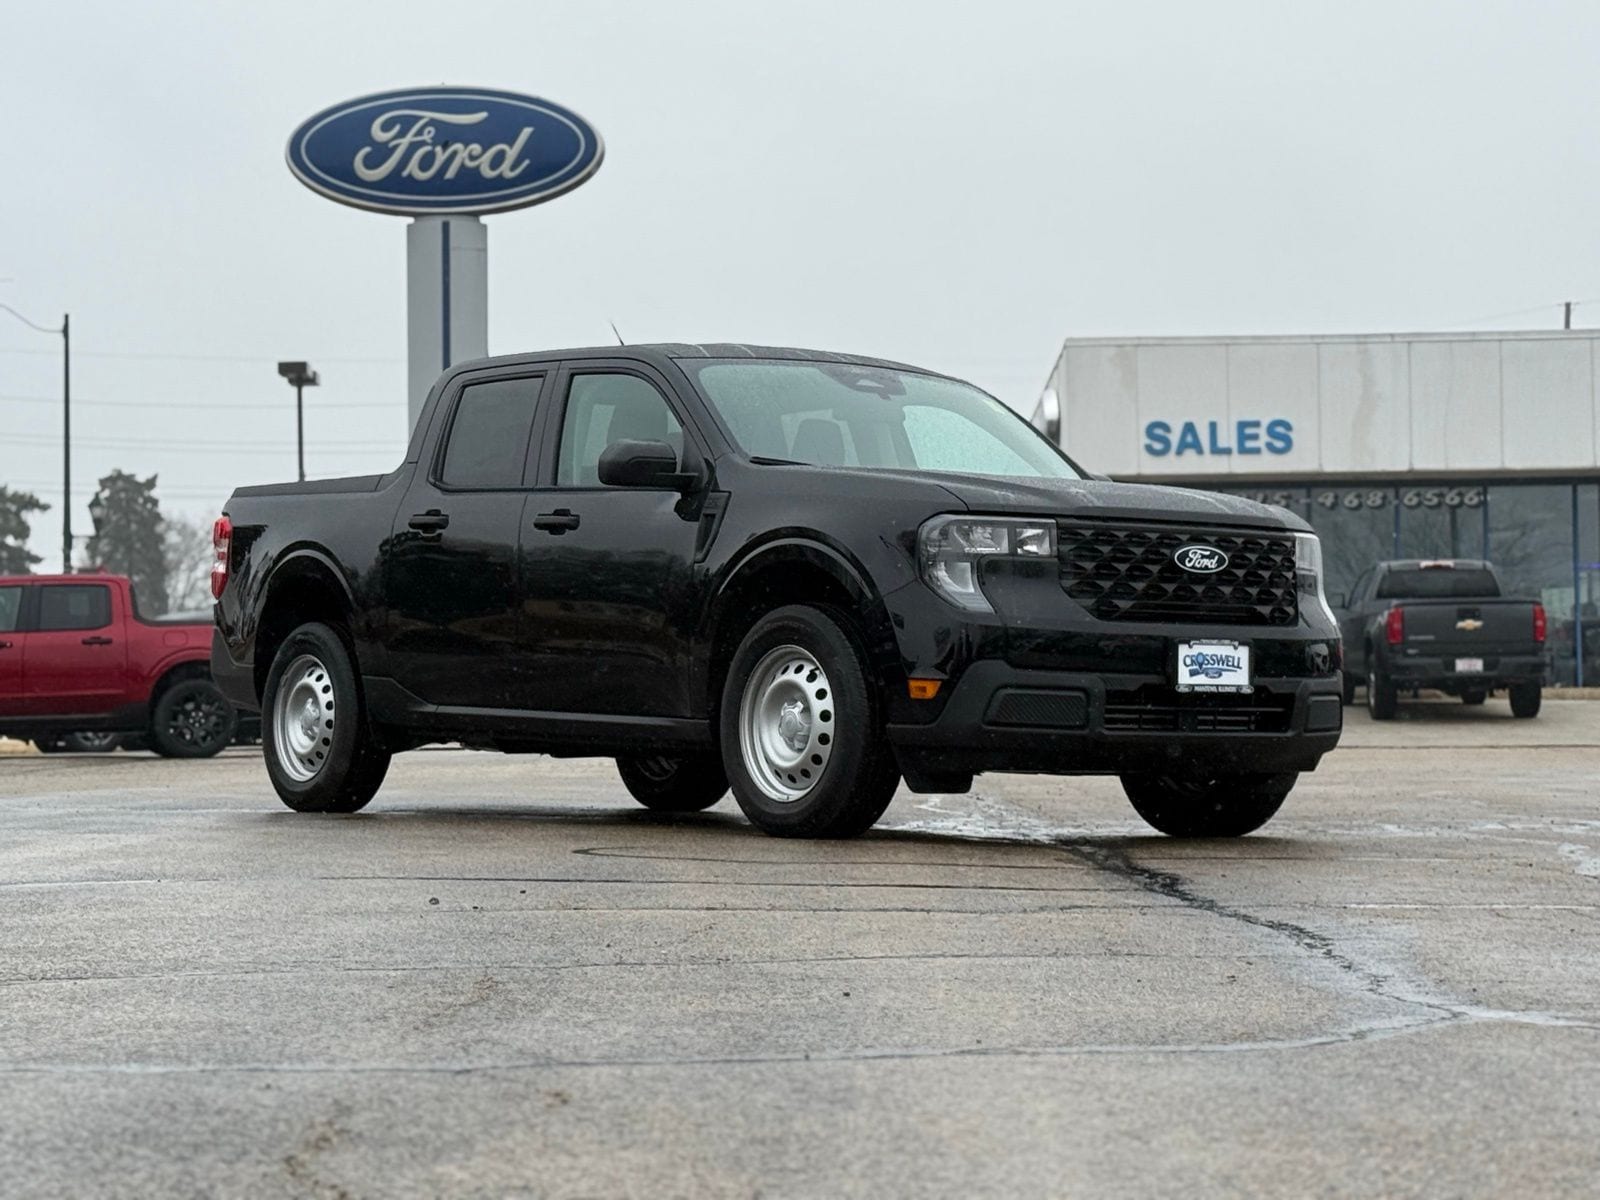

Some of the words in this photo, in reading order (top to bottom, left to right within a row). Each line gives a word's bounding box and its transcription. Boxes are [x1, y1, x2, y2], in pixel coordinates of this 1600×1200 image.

[354, 109, 535, 182] Ford
[1144, 419, 1293, 457] SALES
[1317, 491, 1385, 508] 468
[1403, 488, 1481, 507] 6566
[1185, 548, 1219, 568] Ford
[1183, 652, 1242, 670] CROSSWELL
